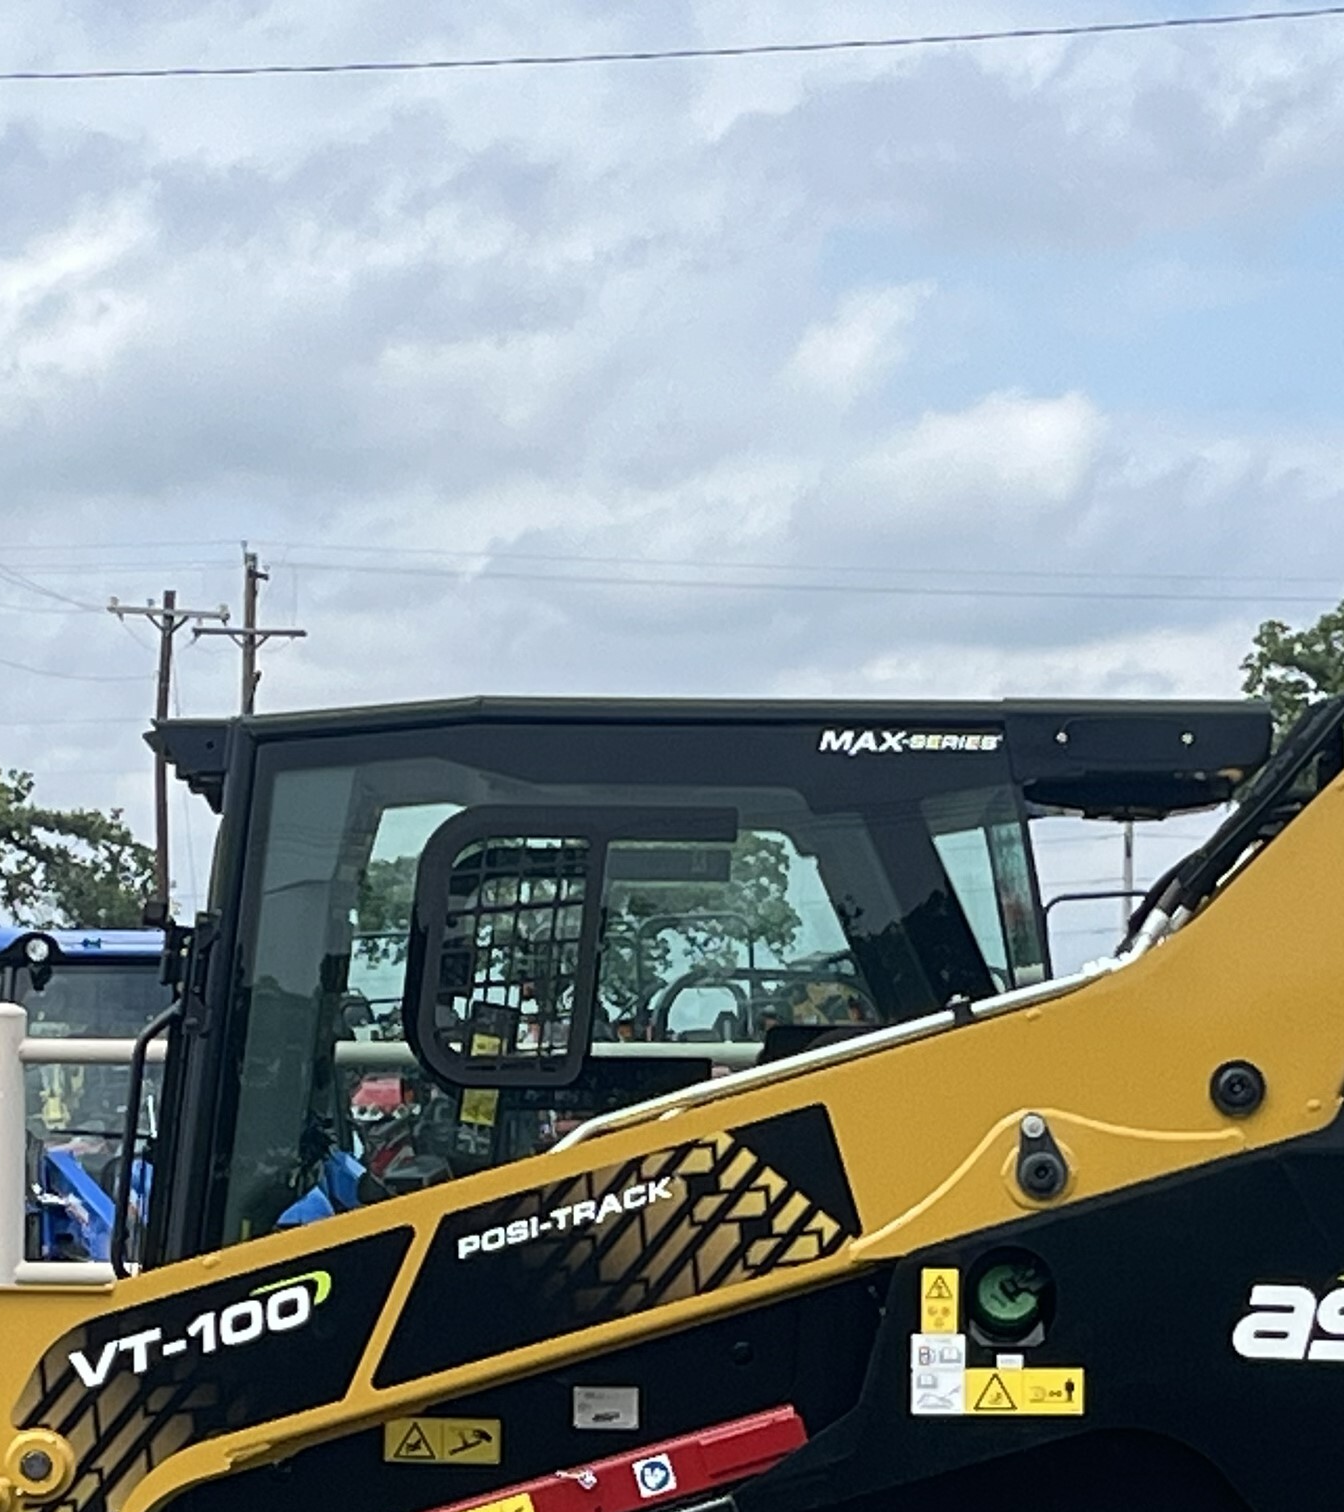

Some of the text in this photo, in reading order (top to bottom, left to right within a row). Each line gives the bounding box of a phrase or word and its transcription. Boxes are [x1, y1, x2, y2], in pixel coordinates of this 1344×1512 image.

[819, 730, 999, 757] MAX-SERIES
[457, 1176, 673, 1260] POSI-TRACK
[68, 1285, 311, 1388] VT-100
